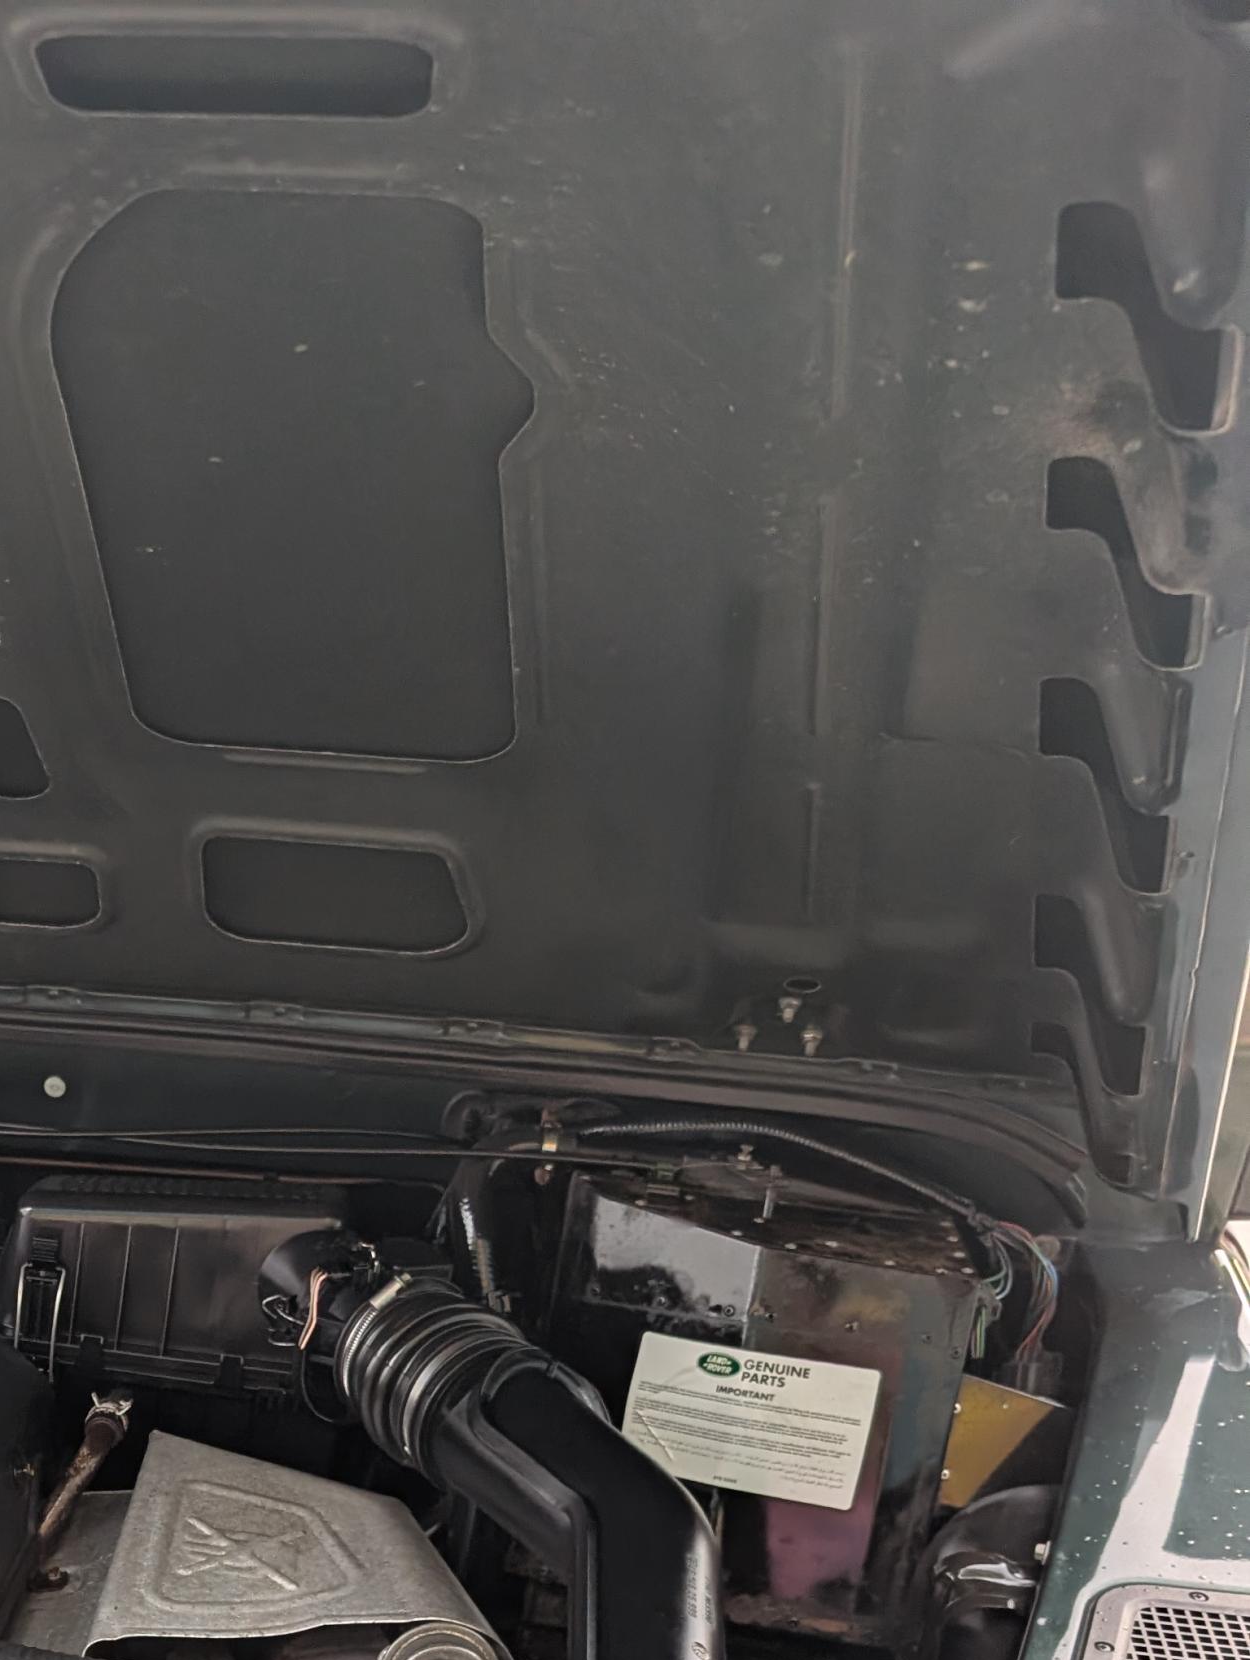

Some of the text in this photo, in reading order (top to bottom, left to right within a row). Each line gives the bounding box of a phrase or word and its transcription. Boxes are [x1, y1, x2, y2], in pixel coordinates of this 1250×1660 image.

[706, 1355, 729, 1366] LAND
[707, 1363, 733, 1375] ROVER
[743, 1358, 812, 1380] GENUINE
[740, 1372, 786, 1388] PARTS
[715, 1384, 776, 1402] IMPORTANT
